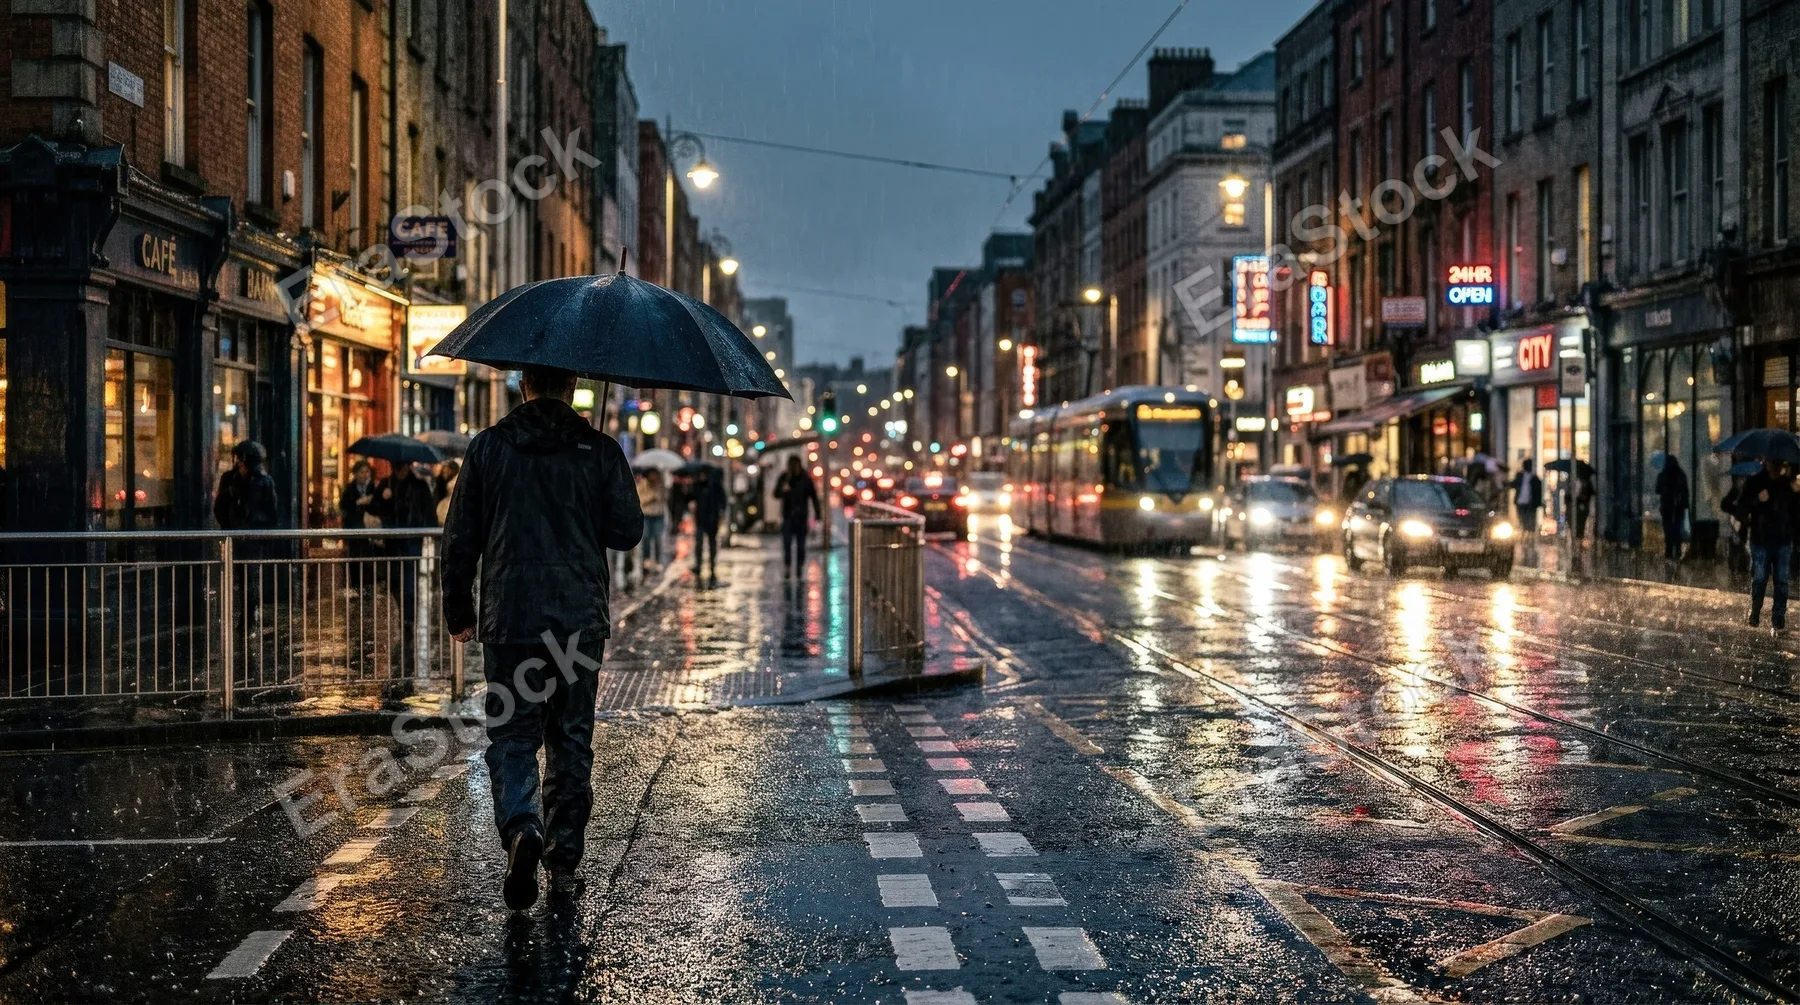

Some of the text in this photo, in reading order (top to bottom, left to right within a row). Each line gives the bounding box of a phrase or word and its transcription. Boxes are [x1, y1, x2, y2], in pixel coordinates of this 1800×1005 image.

[396, 221, 449, 238] CAFE
[142, 233, 177, 275] CAFÉ
[1448, 265, 1493, 284] 24HR
[1448, 287, 1493, 304] OPEN
[1518, 334, 1553, 372] CITY
